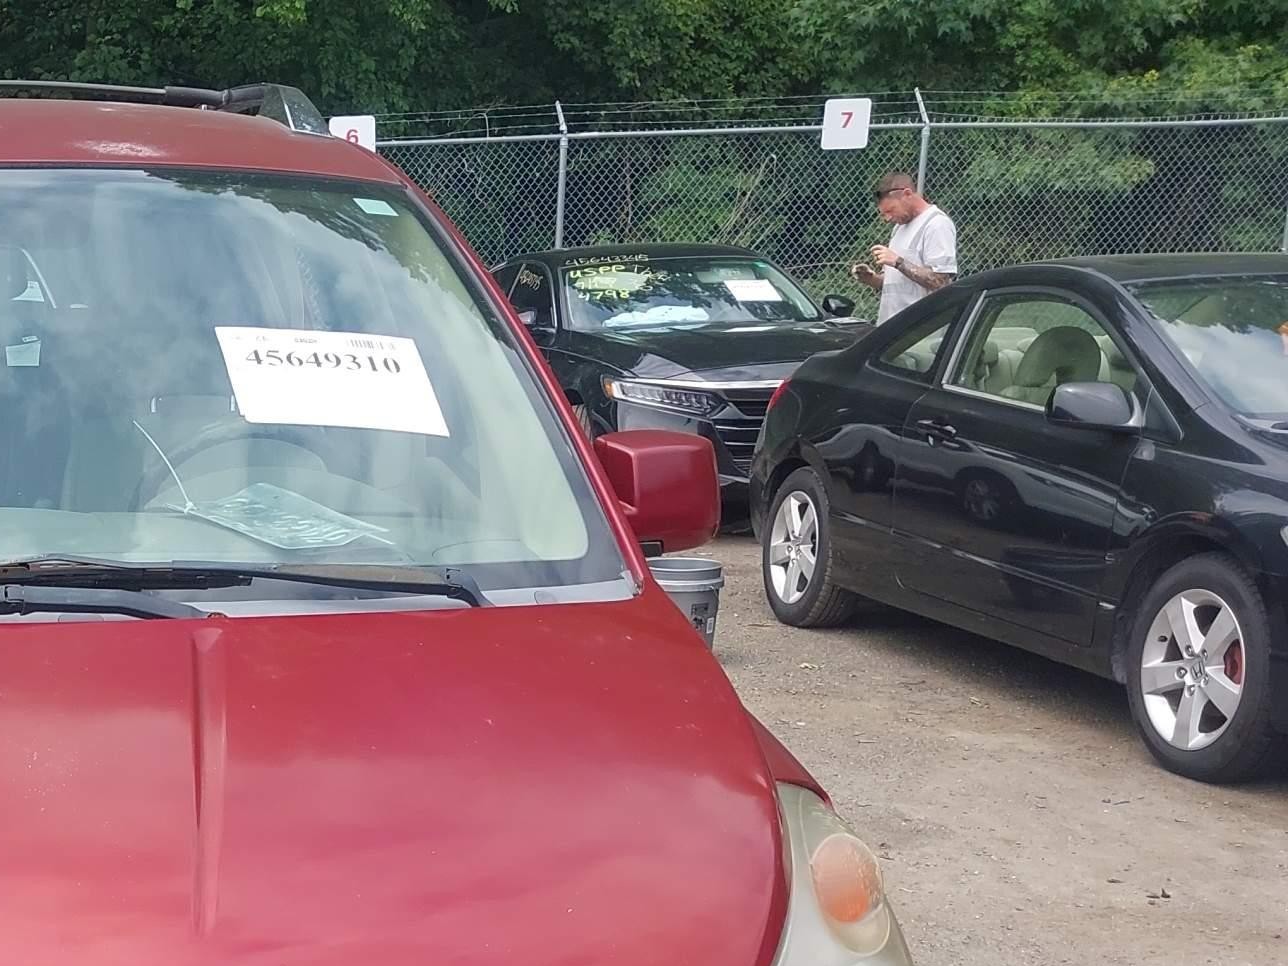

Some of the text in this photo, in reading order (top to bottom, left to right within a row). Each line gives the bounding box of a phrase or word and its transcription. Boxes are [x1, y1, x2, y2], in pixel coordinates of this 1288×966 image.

[841, 111, 854, 129] 7
[346, 128, 359, 145] 6
[245, 349, 401, 374] 45649310
